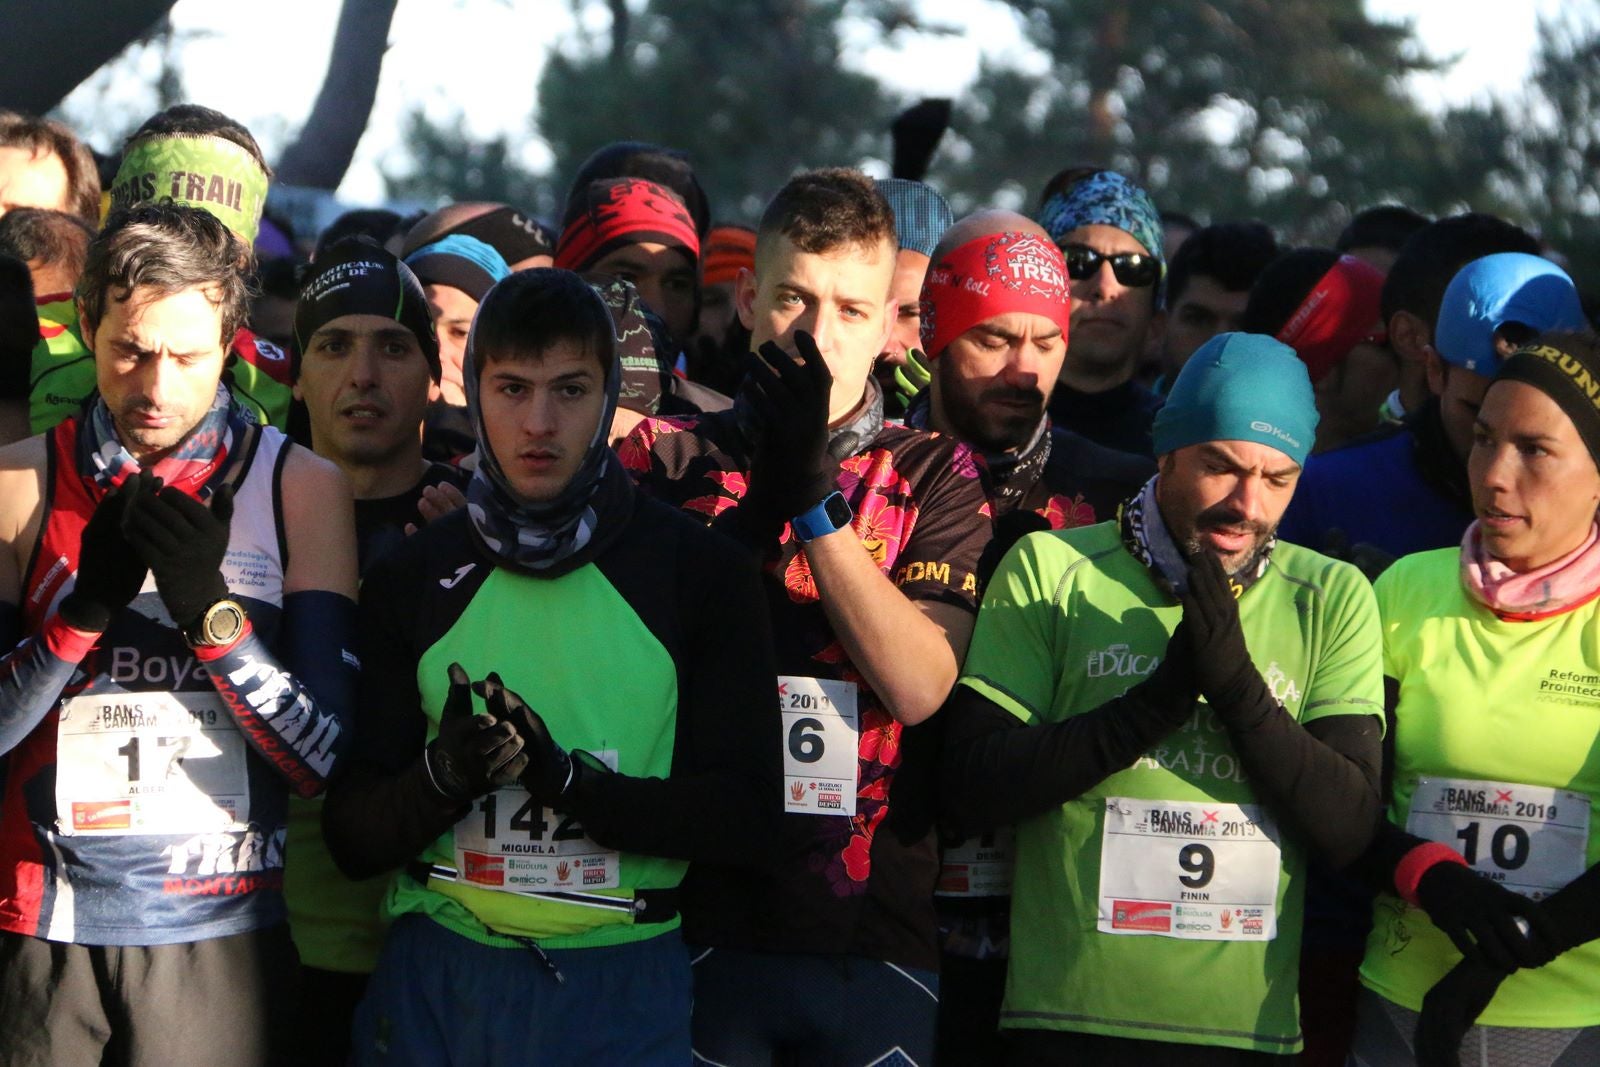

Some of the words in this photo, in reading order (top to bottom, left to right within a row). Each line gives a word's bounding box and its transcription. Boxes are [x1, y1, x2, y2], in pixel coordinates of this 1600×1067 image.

[169, 171, 242, 212] TRAIL
[349, 268, 369, 276] DE
[1008, 263, 1066, 291] TREN
[1537, 345, 1600, 409] RUN
[1550, 669, 1600, 683] Reform
[790, 693, 831, 711] 2019
[228, 655, 342, 778] TRAIL
[788, 717, 826, 764] 6
[1441, 788, 1486, 803] TRANS
[1447, 800, 1510, 816] CANDAMIA
[1515, 801, 1557, 820] 2019
[1151, 821, 1216, 836] CANDAMIA
[1221, 821, 1256, 837] 2019
[501, 844, 544, 854] MIGUEL
[547, 846, 556, 854] A
[1456, 821, 1530, 871] 10
[1178, 843, 1215, 889] 9
[1180, 891, 1210, 900] FININ
